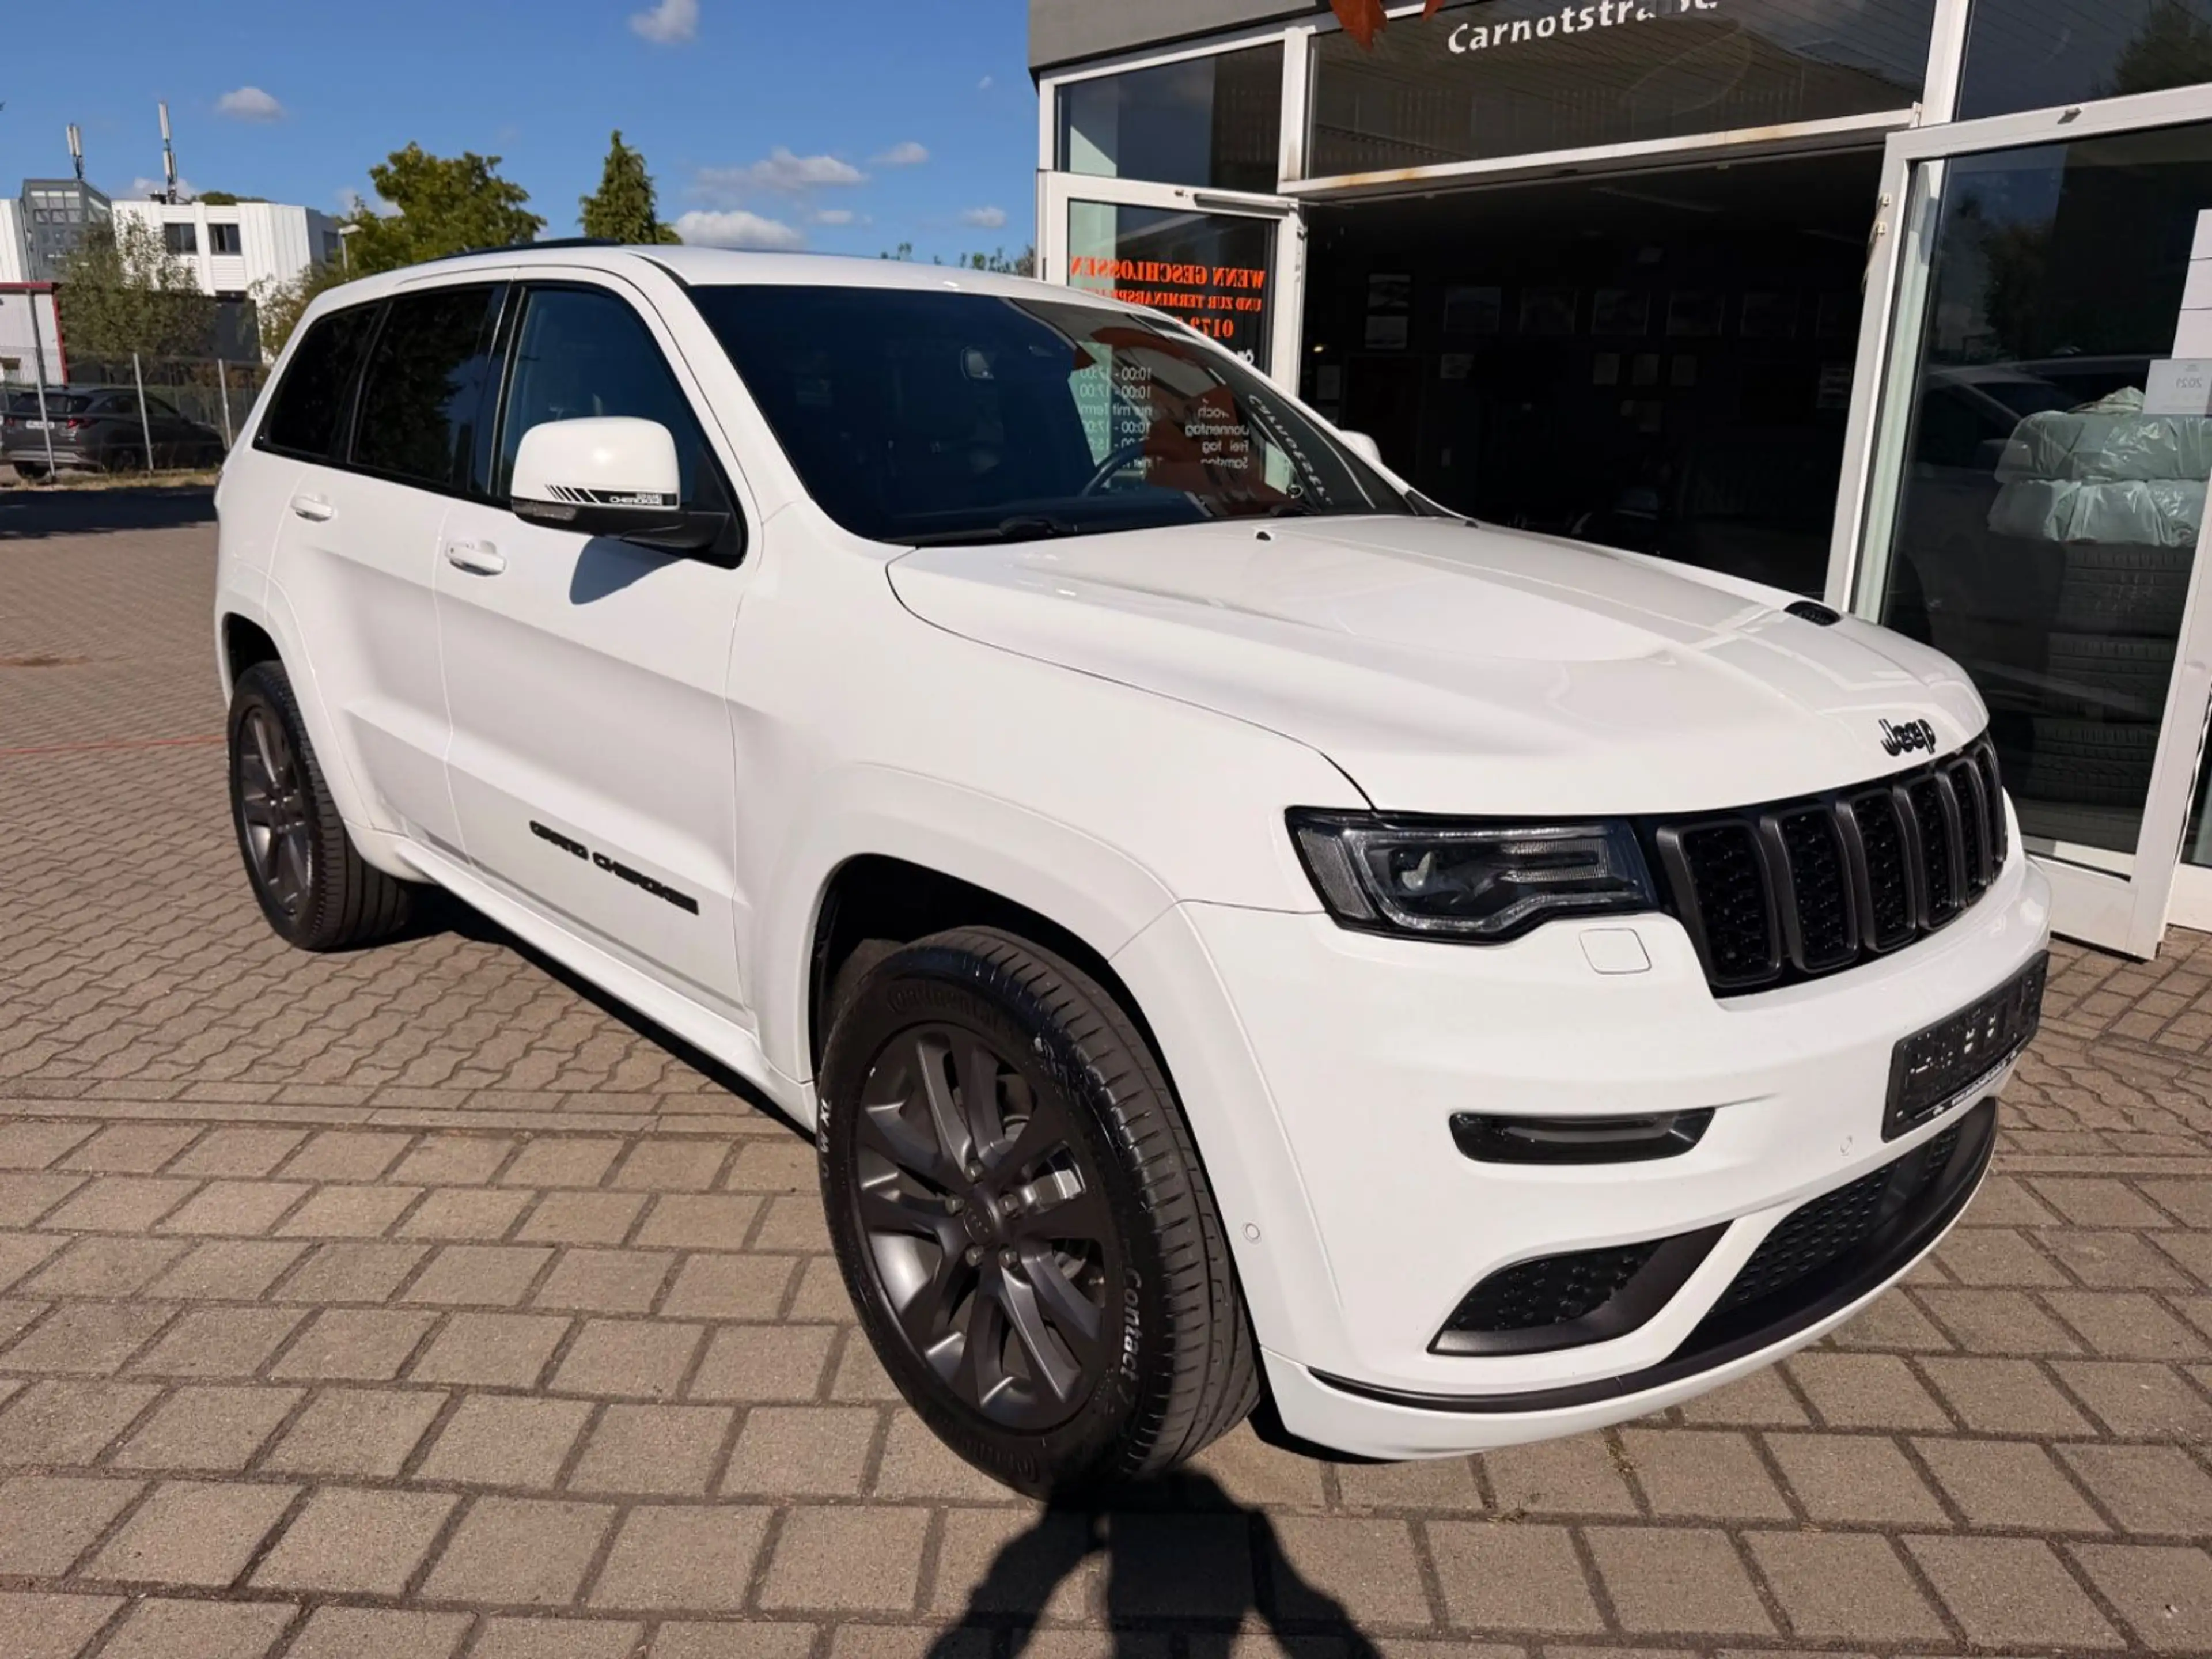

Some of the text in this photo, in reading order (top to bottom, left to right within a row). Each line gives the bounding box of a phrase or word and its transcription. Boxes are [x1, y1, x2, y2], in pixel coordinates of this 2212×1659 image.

[1878, 718, 1936, 757] Jeep
[592, 851, 699, 916] CHEROKEE
[1120, 1267, 1143, 1382] Contact
